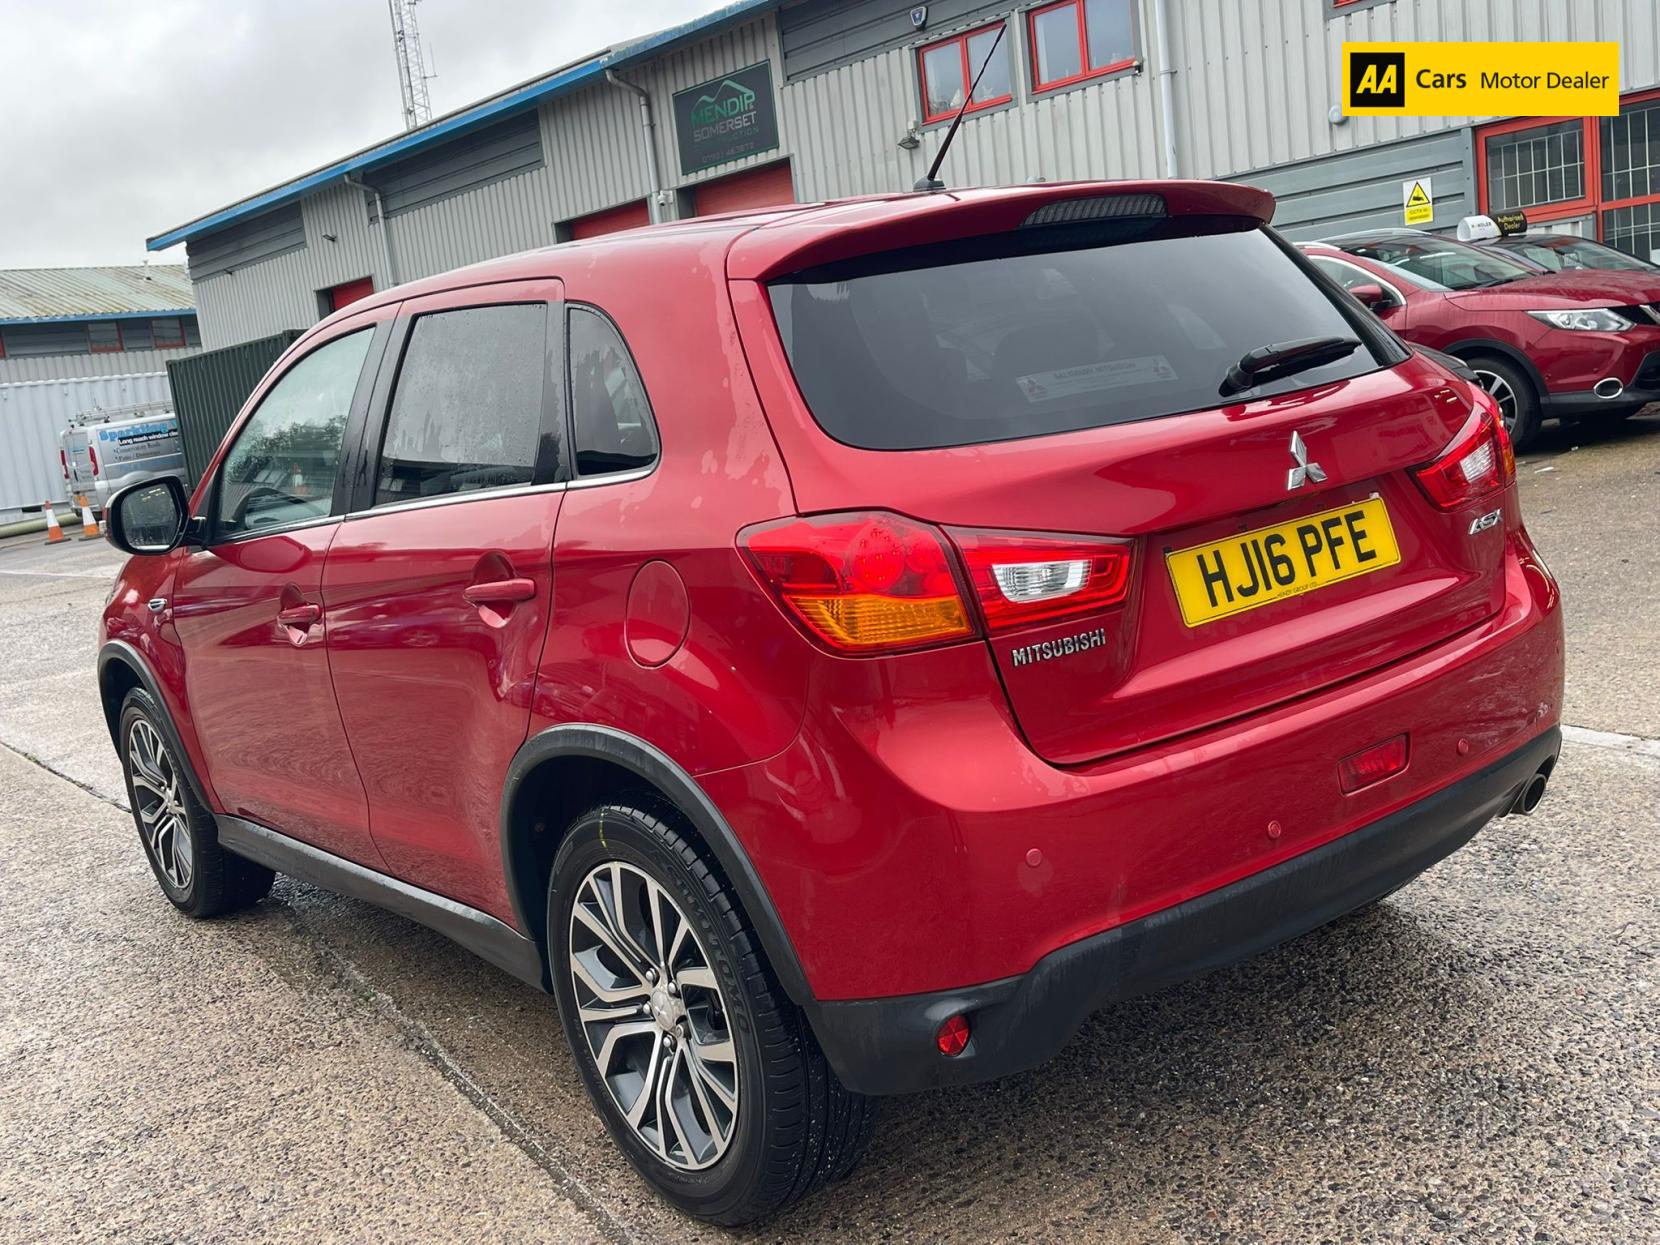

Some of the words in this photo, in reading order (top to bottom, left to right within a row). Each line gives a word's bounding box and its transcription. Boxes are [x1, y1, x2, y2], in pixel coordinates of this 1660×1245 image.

[691, 92, 755, 128] MENDIP
[693, 111, 757, 142] SOMERSET
[119, 438, 134, 446] Long
[149, 431, 169, 440] window
[1197, 533, 1296, 608] HJ16
[1297, 510, 1377, 578] PFE
[1012, 628, 1107, 667] MITSUBISHI
